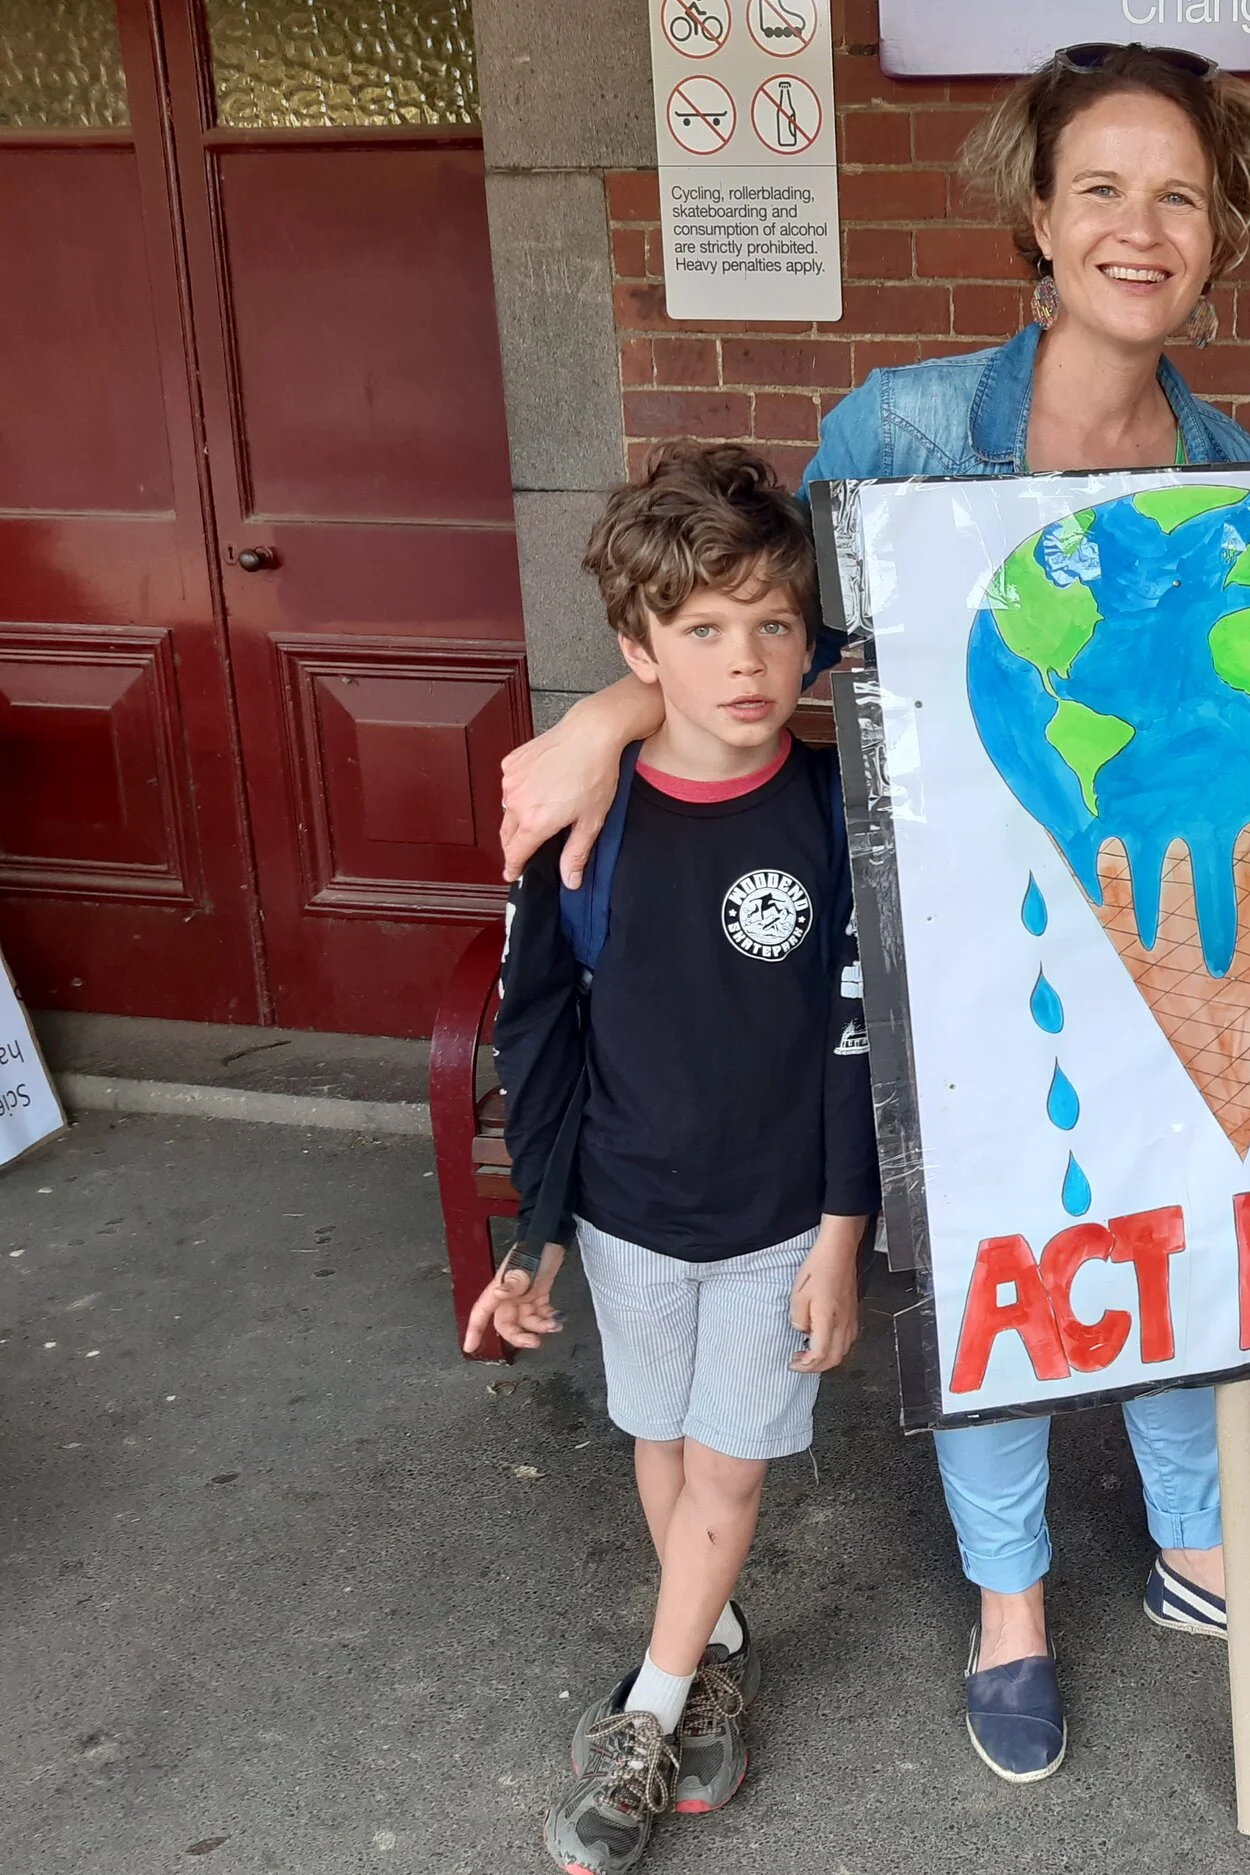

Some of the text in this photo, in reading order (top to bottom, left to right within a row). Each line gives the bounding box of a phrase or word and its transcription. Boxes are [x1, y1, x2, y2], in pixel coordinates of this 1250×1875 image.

[671, 185, 815, 204] Cycling, rollerblading,
[672, 204, 797, 221] skateboarding and
[673, 222, 827, 239] consumption of alcohol
[674, 240, 818, 257] are strictly prohibited.
[675, 257, 825, 275] Heavy penalties apply.
[728, 872, 809, 912] WOODEND
[727, 921, 804, 957] SKATEPARK
[949, 1205, 1186, 1394] ACT
